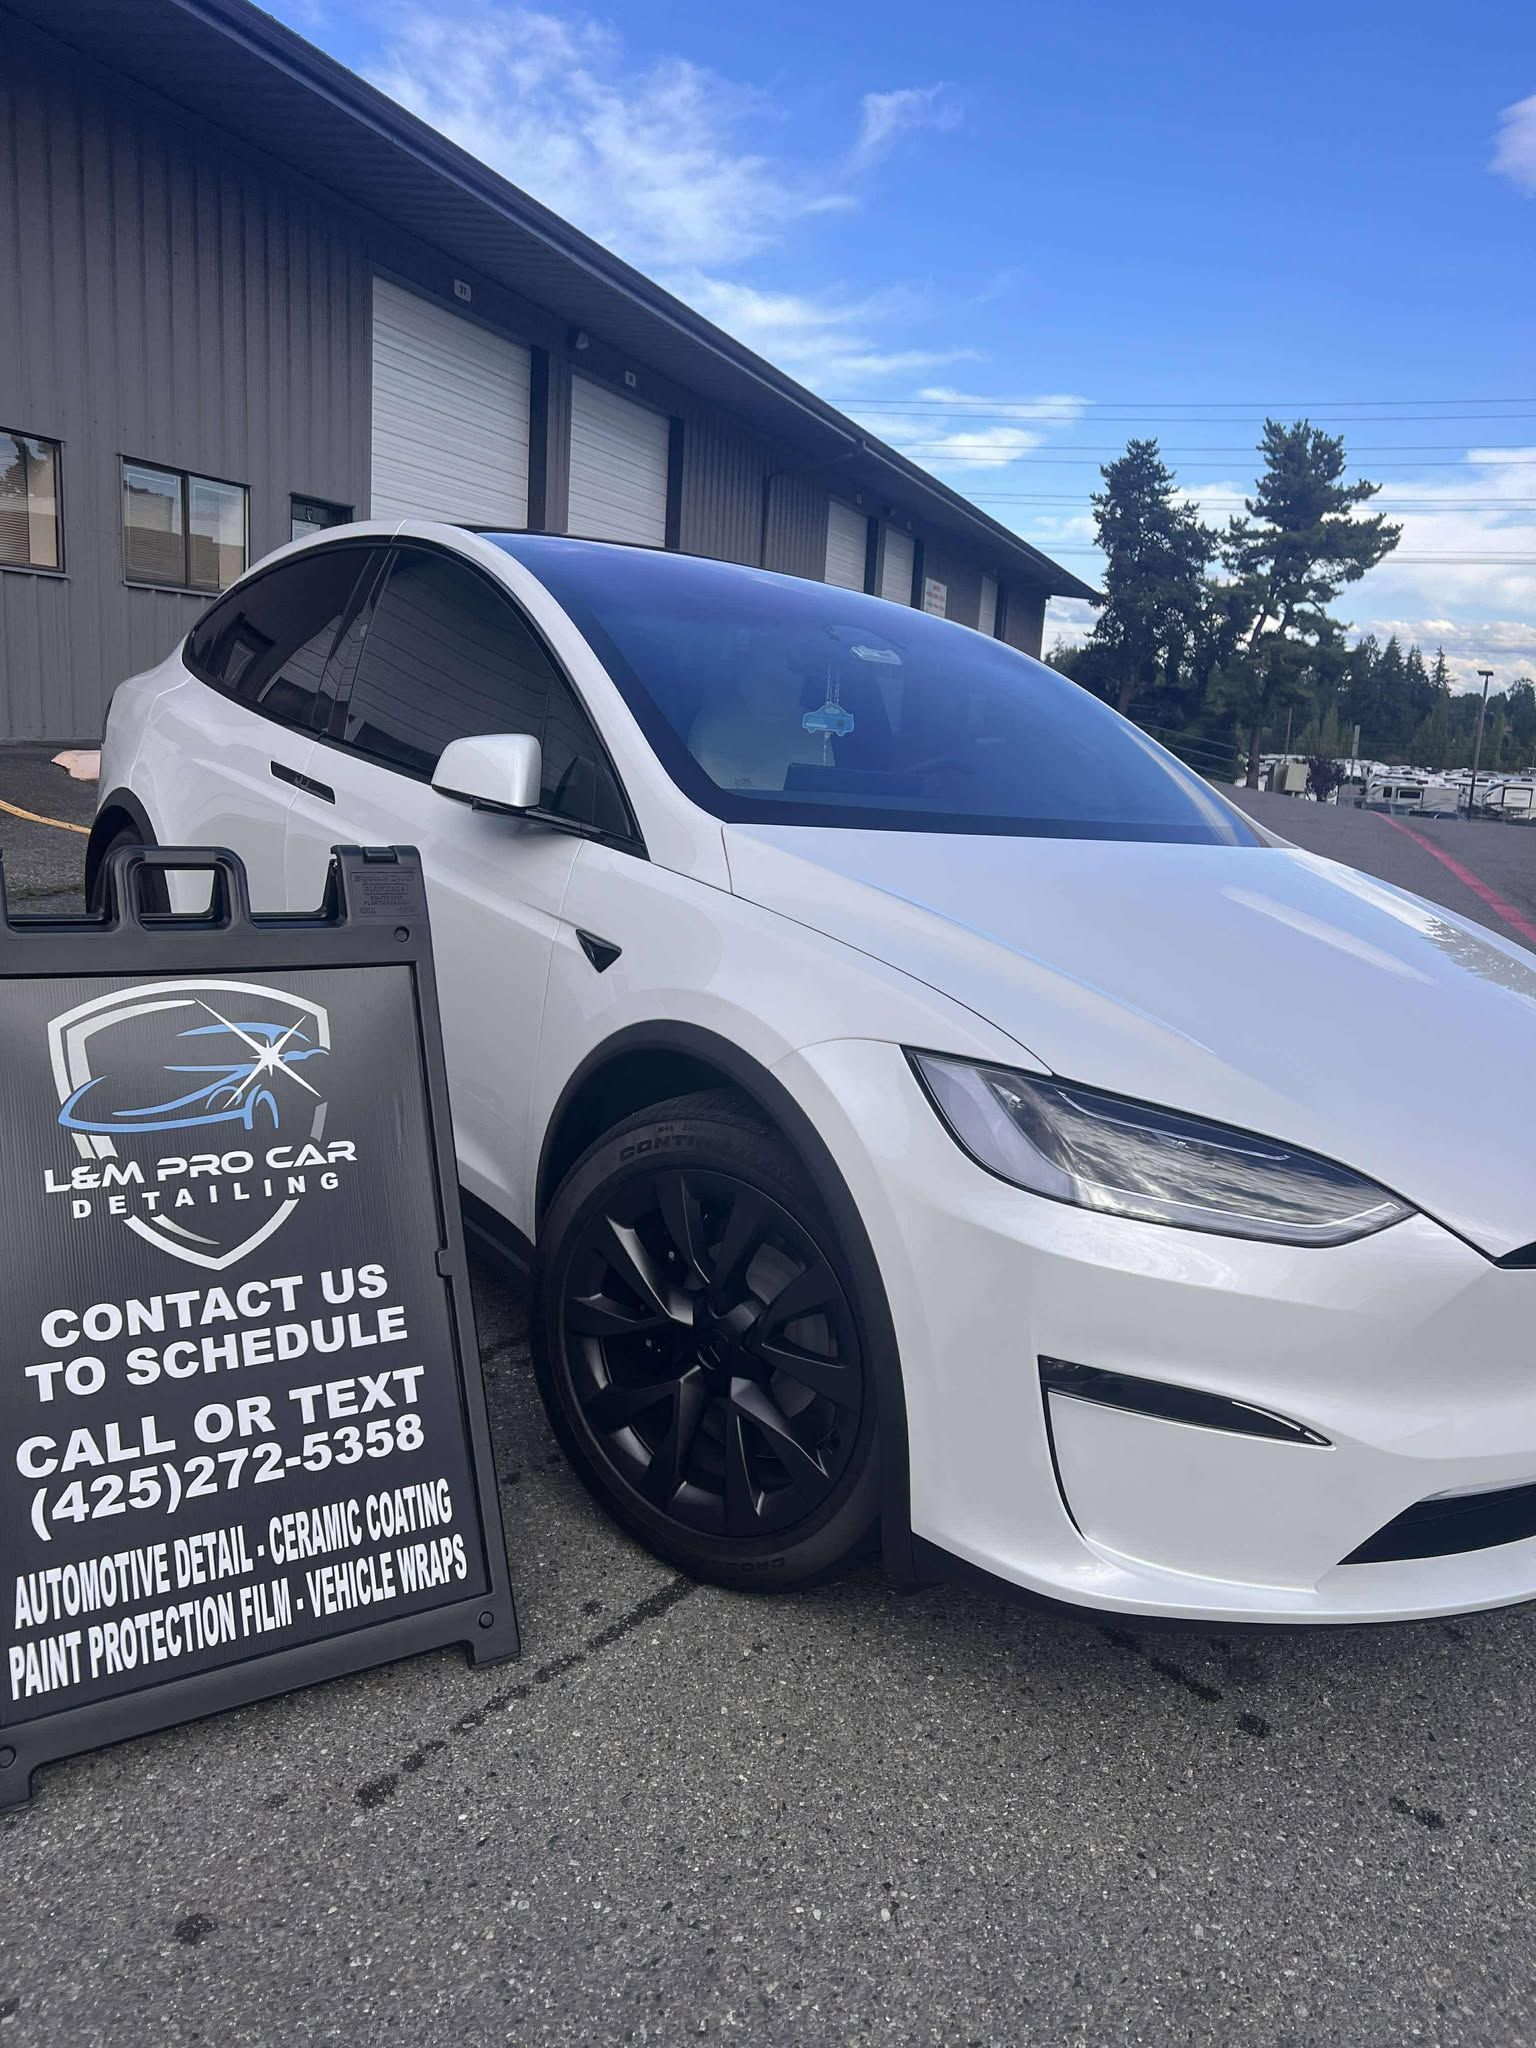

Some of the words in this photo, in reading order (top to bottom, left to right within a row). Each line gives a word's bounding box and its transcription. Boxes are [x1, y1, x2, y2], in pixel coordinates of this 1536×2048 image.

[43, 1160, 146, 1194] L&M
[156, 1150, 254, 1182] PRO
[265, 1140, 358, 1169] CAR
[71, 1171, 339, 1219] DETAILING
[24, 1356, 106, 1403] TO
[126, 1305, 408, 1386] SCHEDULE
[40, 1275, 304, 1348] CONTACT
[320, 1263, 388, 1304] US
[16, 1415, 177, 1479] CALL
[193, 1395, 276, 1444] OR
[288, 1365, 425, 1425] TEXT
[30, 1413, 425, 1542] (425)272-5358
[14, 1542, 171, 1630] AUTOMOTIVE
[173, 1525, 254, 1589] DETAIL
[269, 1498, 363, 1565] CERAMIC
[365, 1477, 453, 1541] COATING
[8, 1630, 82, 1701] PAINT
[87, 1591, 237, 1679] PROTECTION
[239, 1577, 293, 1637] FILM
[305, 1551, 397, 1618] VEHICLE
[396, 1533, 467, 1594] WRAPS
